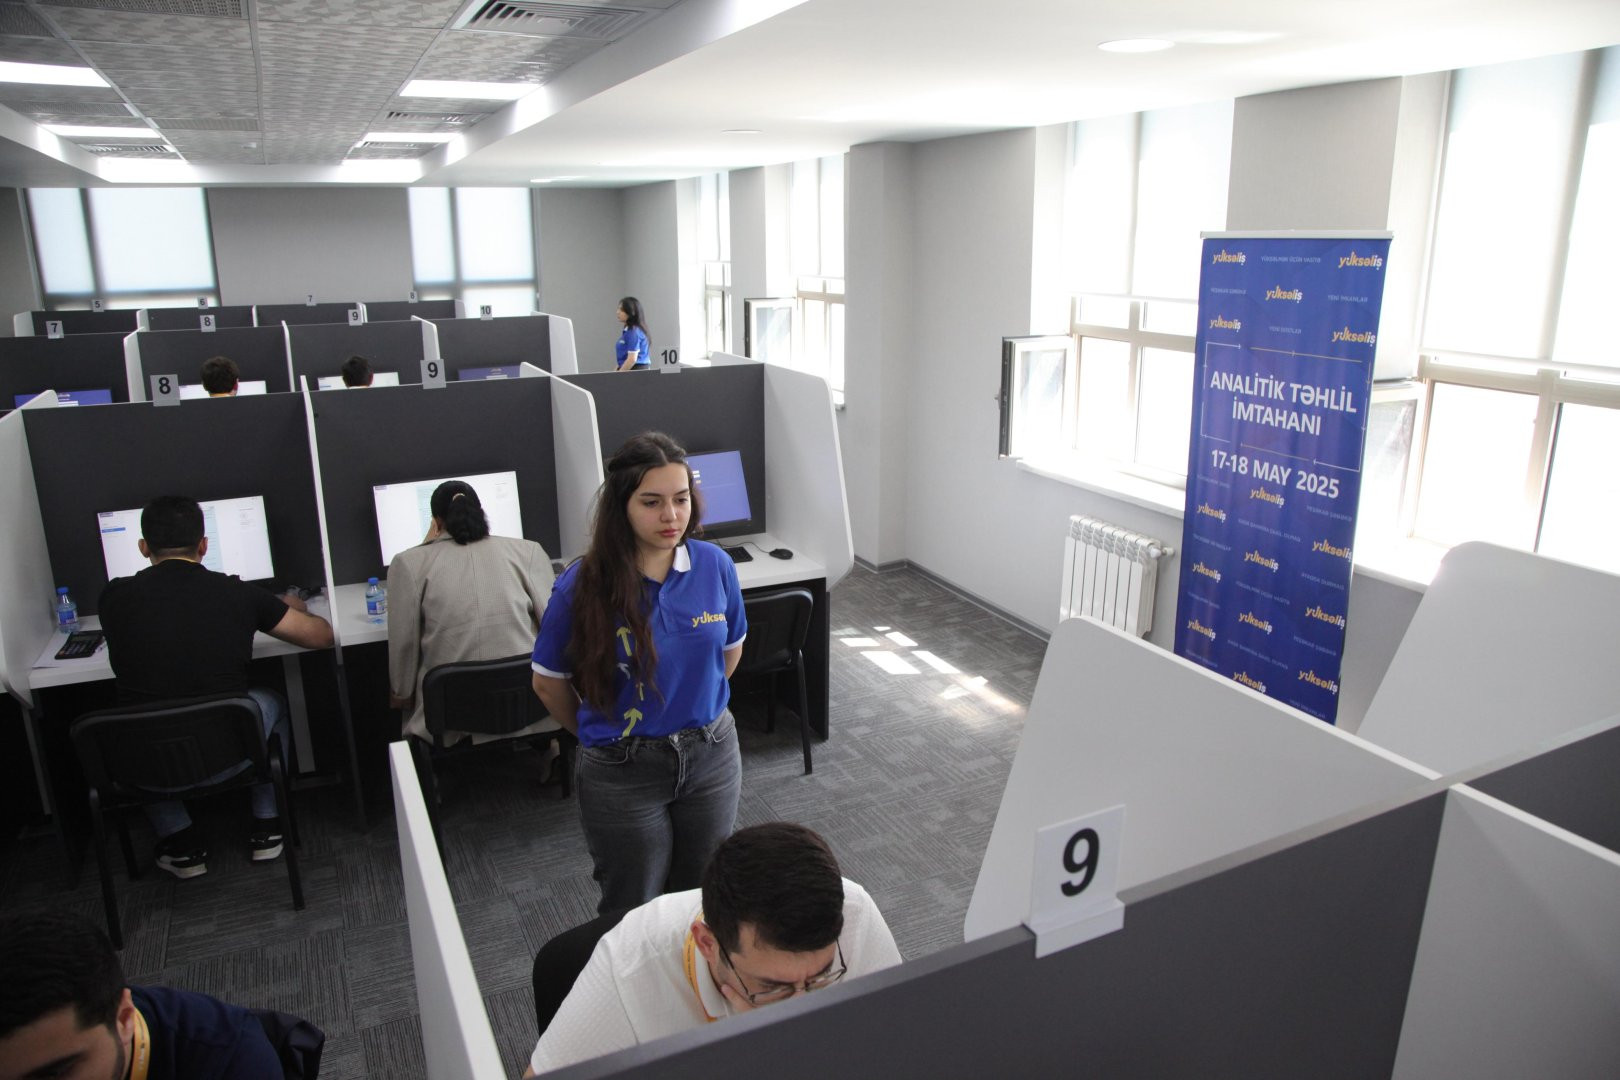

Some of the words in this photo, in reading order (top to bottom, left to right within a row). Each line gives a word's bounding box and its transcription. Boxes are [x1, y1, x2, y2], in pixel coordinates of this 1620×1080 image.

[95, 301, 100, 309] 5
[480, 306, 491, 315] 10
[204, 316, 211, 326] 8
[352, 312, 358, 321] 9
[50, 322, 58, 333] 7
[661, 350, 677, 364] 10
[427, 362, 438, 378] 9
[159, 377, 171, 395] 8
[1210, 370, 1286, 401] ANALİTİK
[1290, 383, 1357, 414] TƏHLİL
[1232, 396, 1321, 436] İMTAHANI
[1211, 449, 1248, 475] 17-18
[1252, 459, 1292, 486] MAY
[1296, 471, 1340, 499] 2025
[1061, 828, 1100, 897] 9
